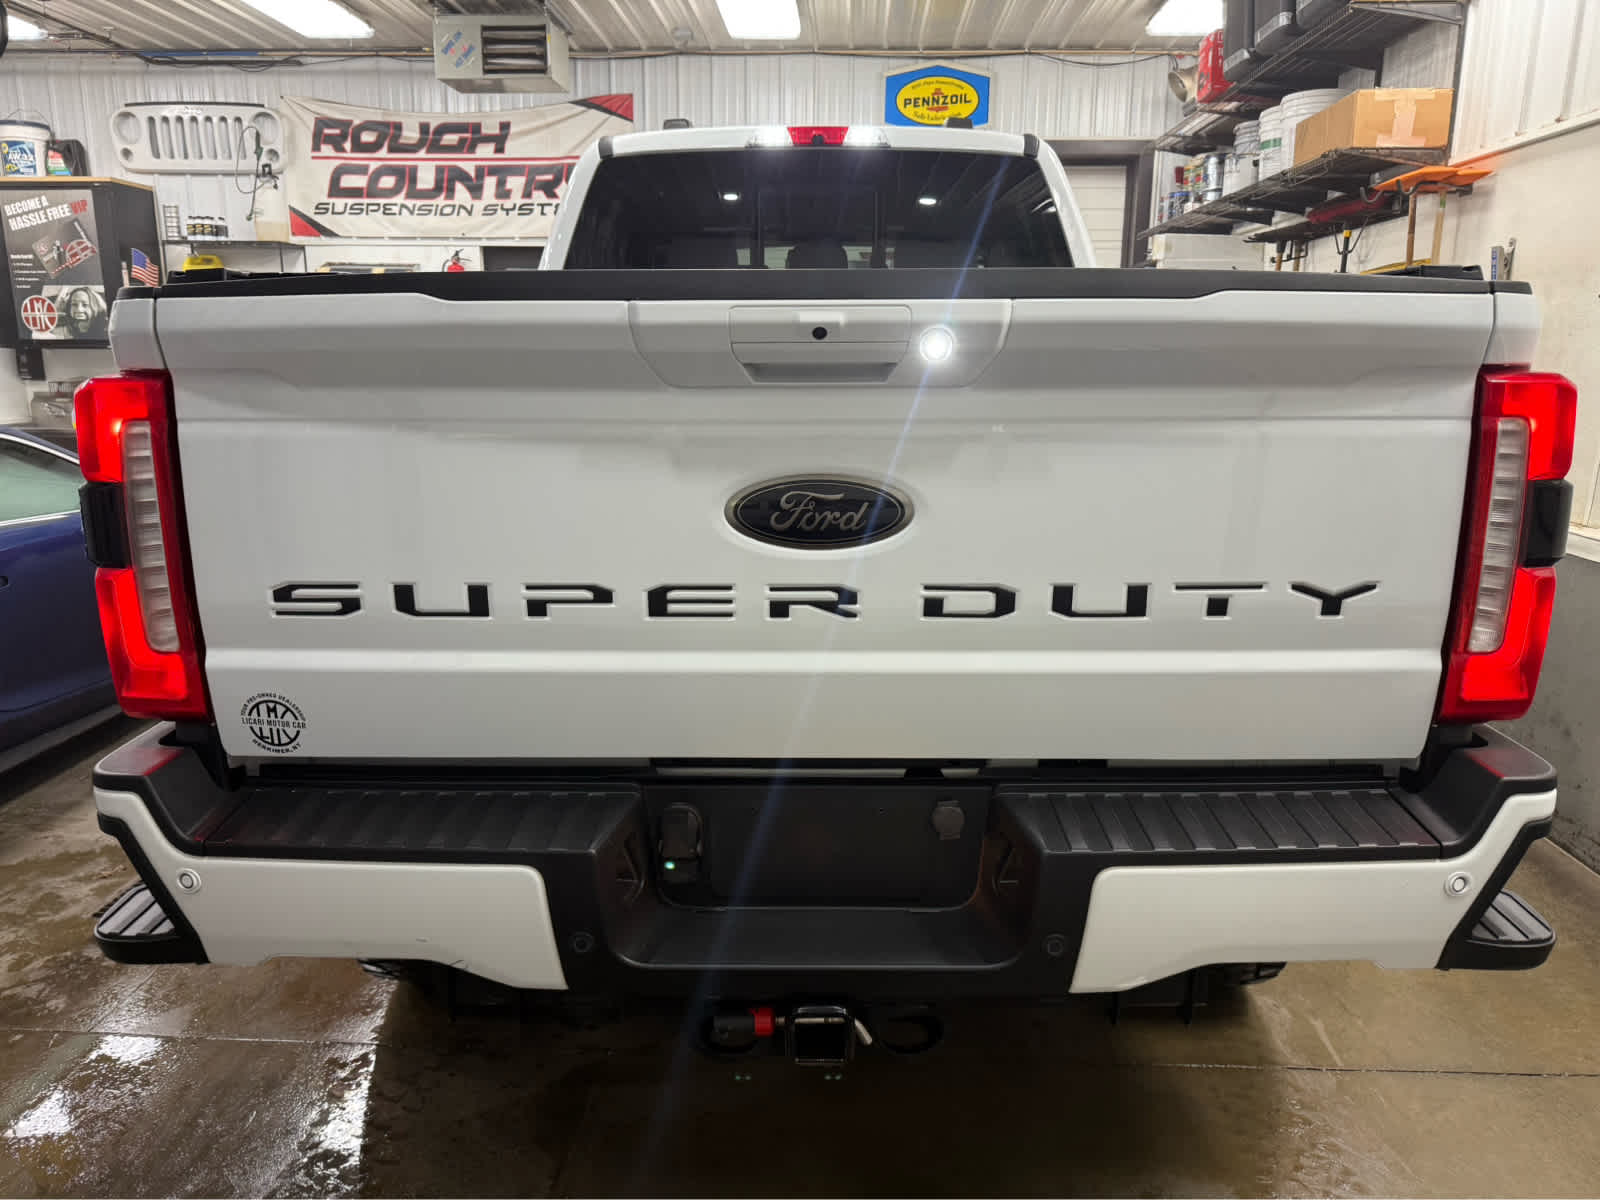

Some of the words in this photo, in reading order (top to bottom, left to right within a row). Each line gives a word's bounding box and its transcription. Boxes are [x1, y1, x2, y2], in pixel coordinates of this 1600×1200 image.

[903, 93, 972, 108] PENNZOIL
[311, 117, 511, 154] ROUGH
[327, 163, 577, 199] COUNTR
[4, 197, 42, 216] BECOME
[40, 195, 49, 207] A
[8, 210, 48, 231] HASSLE
[46, 203, 72, 221] FREE
[70, 199, 88, 215] VIP
[314, 202, 474, 217] SUSPENSION
[770, 490, 870, 532] Ford
[271, 582, 859, 619] SUPER
[921, 581, 1379, 619] DUTY
[266, 719, 291, 729] MOTOR
[292, 721, 307, 729] CAR
